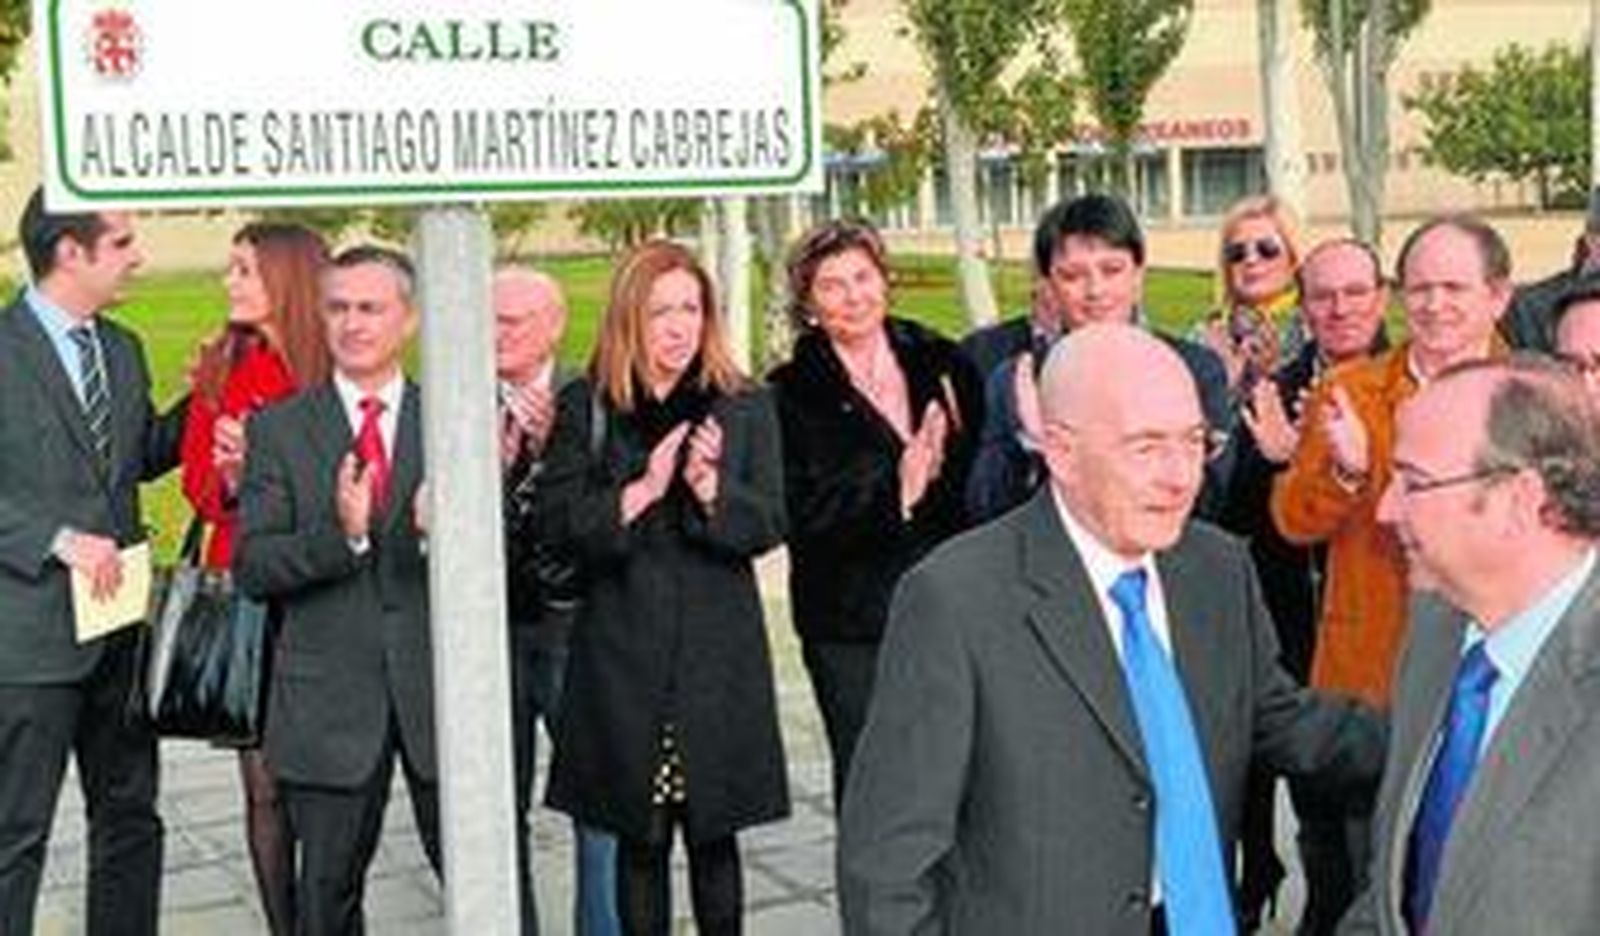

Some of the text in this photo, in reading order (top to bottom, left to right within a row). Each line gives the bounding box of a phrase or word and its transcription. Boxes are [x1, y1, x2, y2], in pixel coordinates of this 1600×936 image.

[361, 19, 560, 61] CALLE
[80, 94, 792, 177] ALCALDE SANTIAGO MARTÍNEZ CABREJAS
